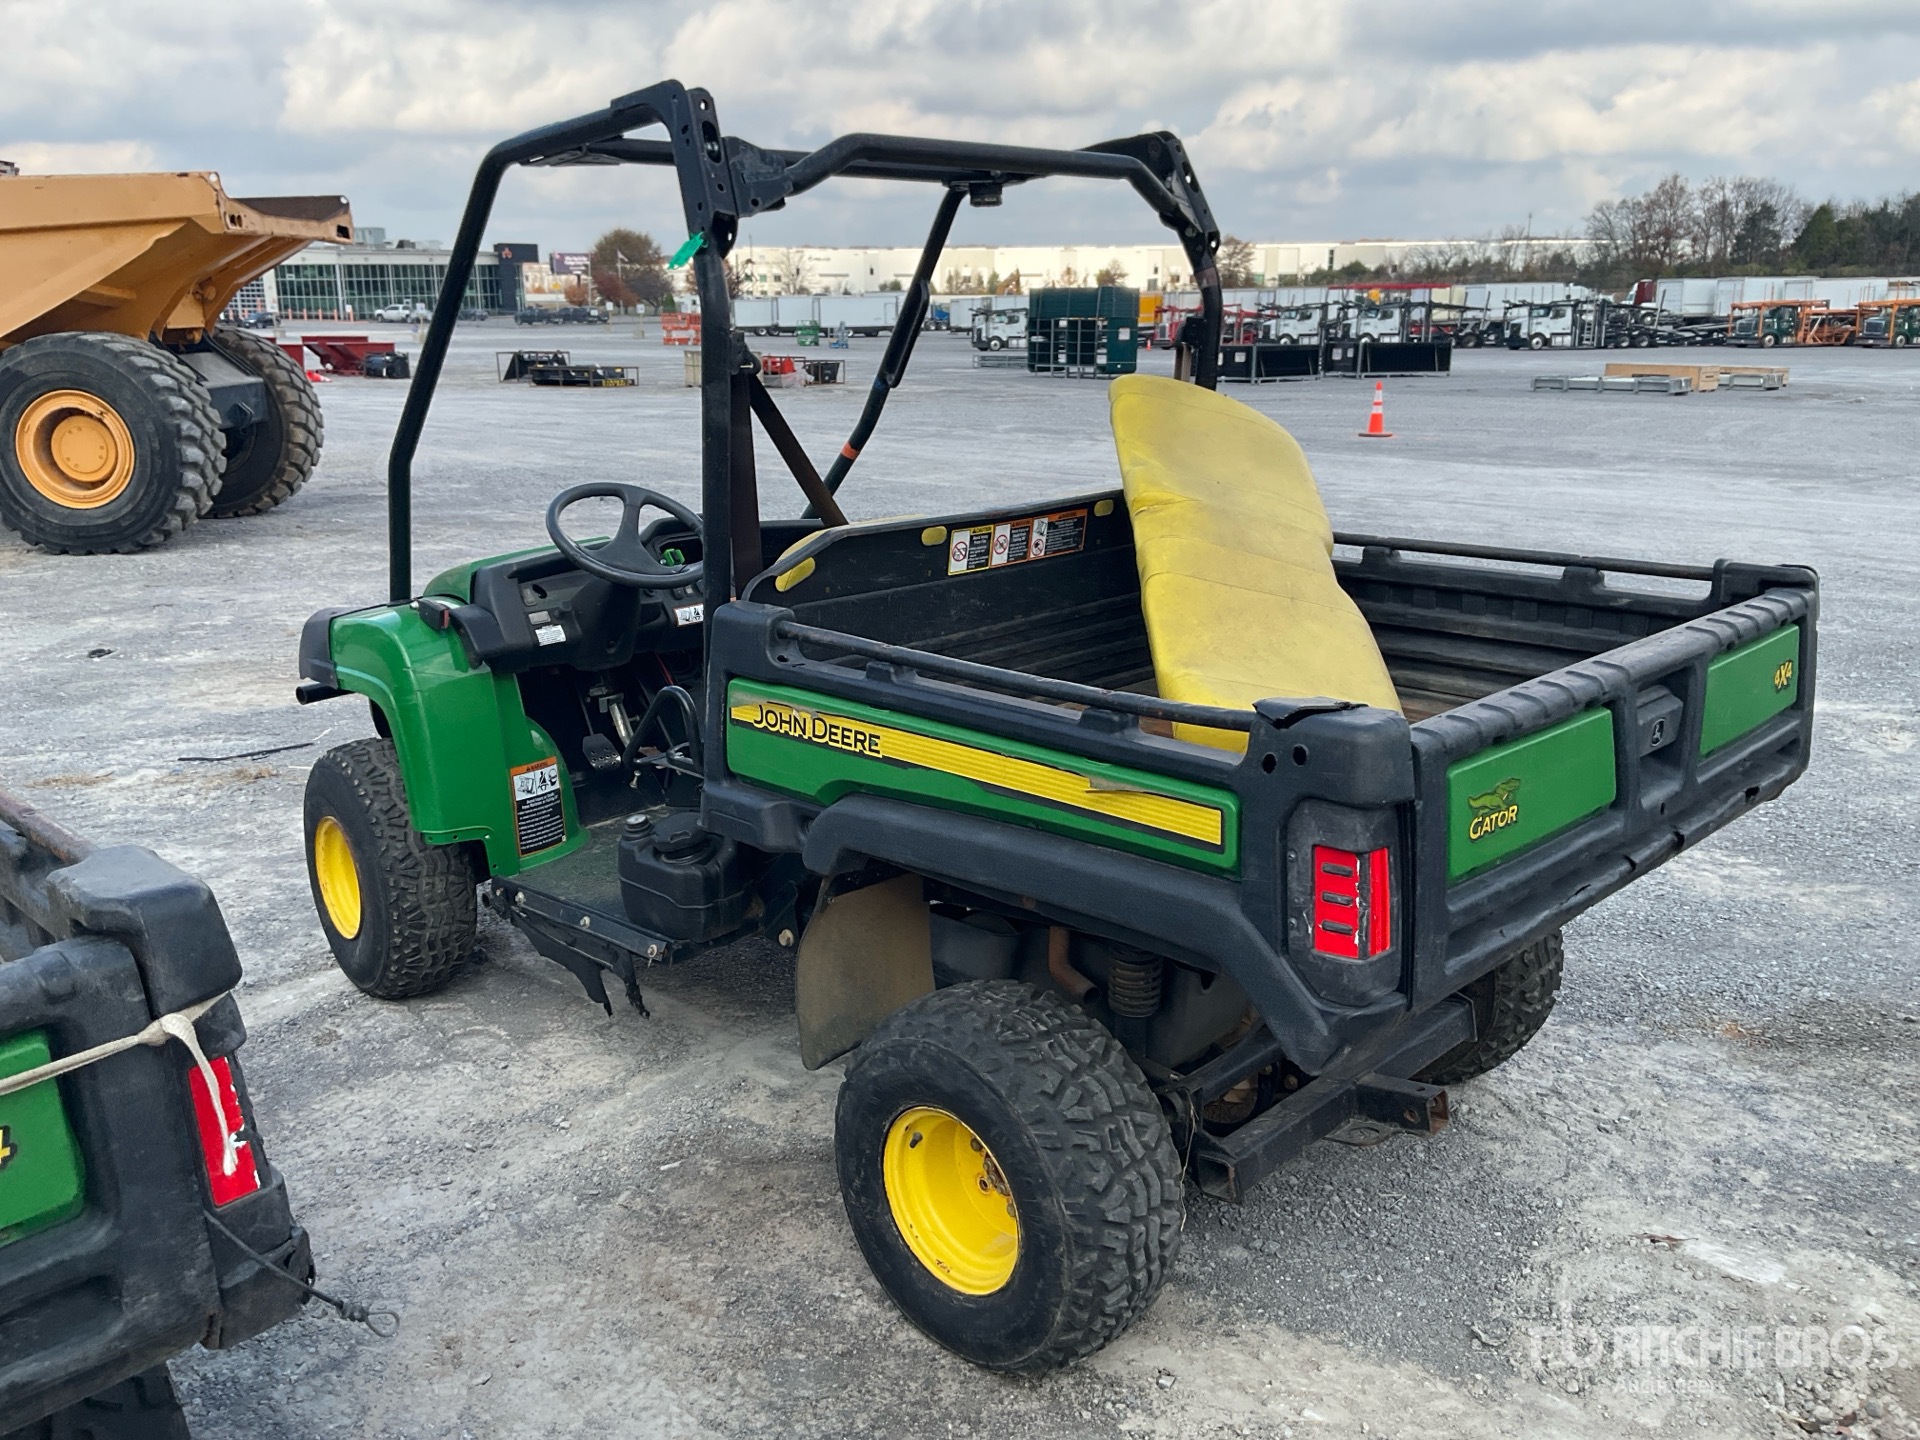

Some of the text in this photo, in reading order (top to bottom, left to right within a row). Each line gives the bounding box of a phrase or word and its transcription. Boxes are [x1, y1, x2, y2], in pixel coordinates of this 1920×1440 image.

[753, 704, 881, 754] JOHN DEERE
[1469, 804, 1518, 840] GATOR
